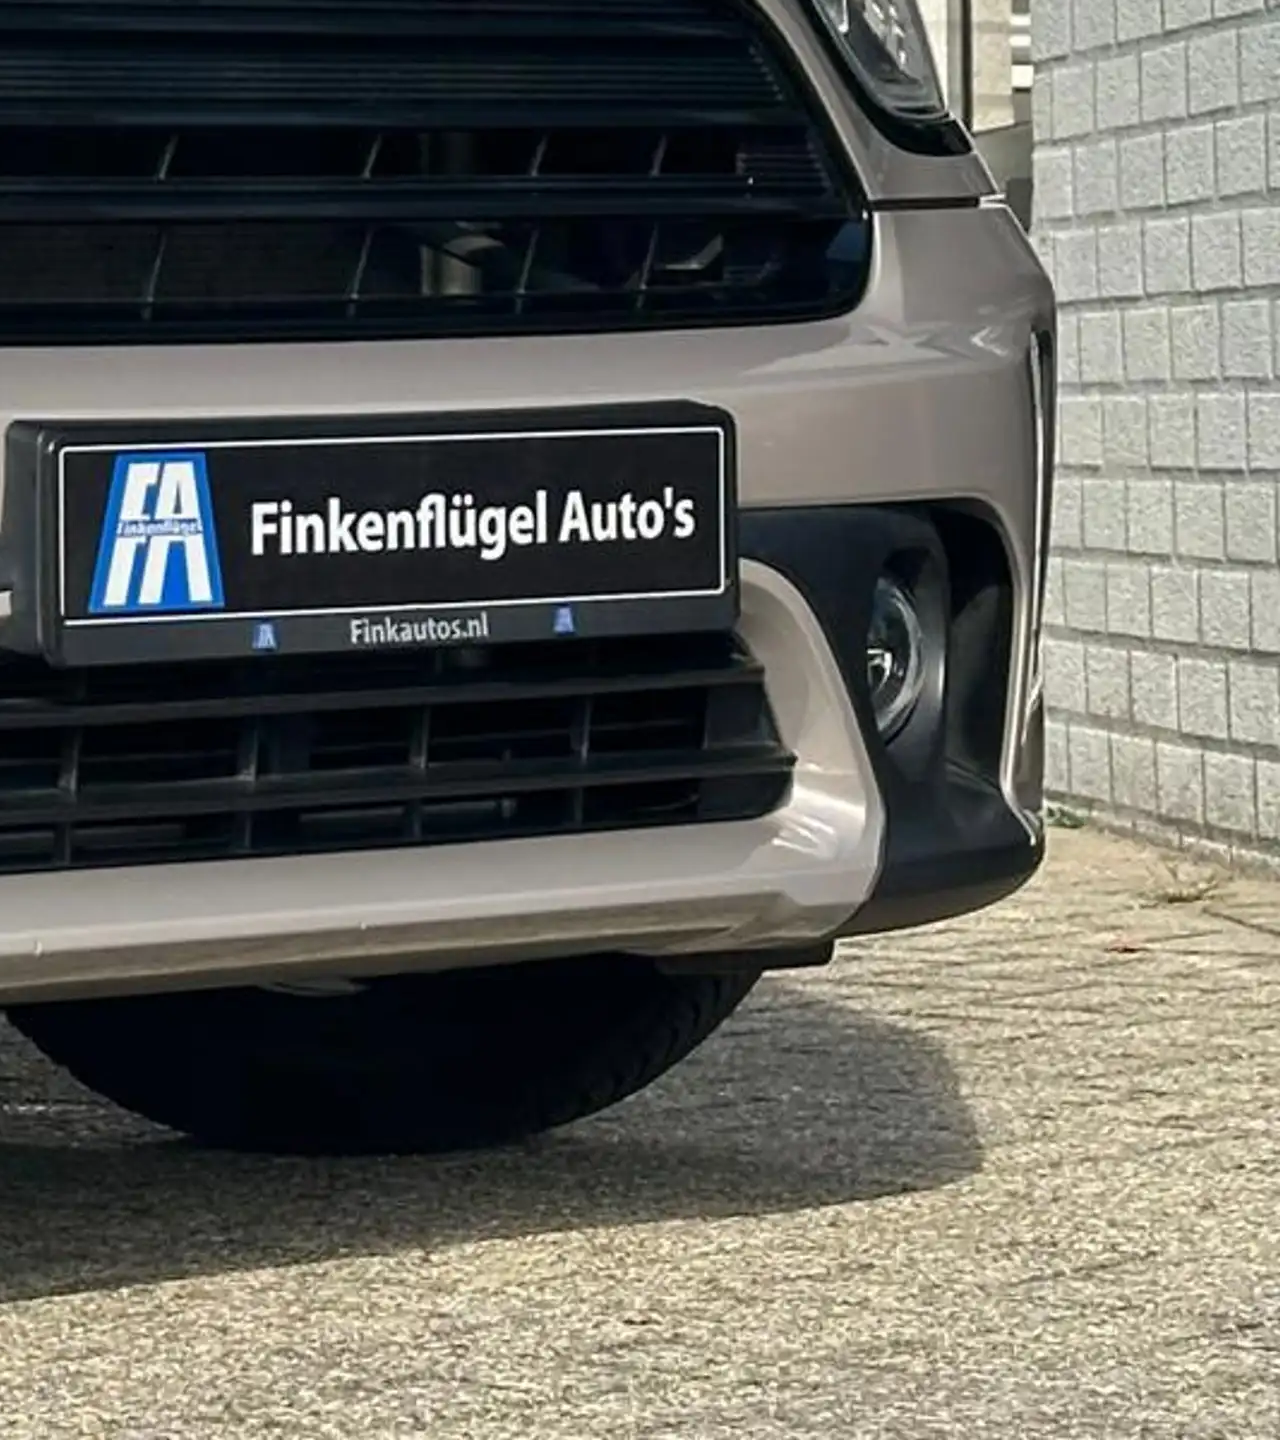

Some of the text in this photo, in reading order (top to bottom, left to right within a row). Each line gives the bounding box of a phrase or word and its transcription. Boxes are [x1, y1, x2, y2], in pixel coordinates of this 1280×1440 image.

[251, 486, 695, 561] Finkenflügel Auto's
[349, 610, 489, 646] Finkautos.nl
